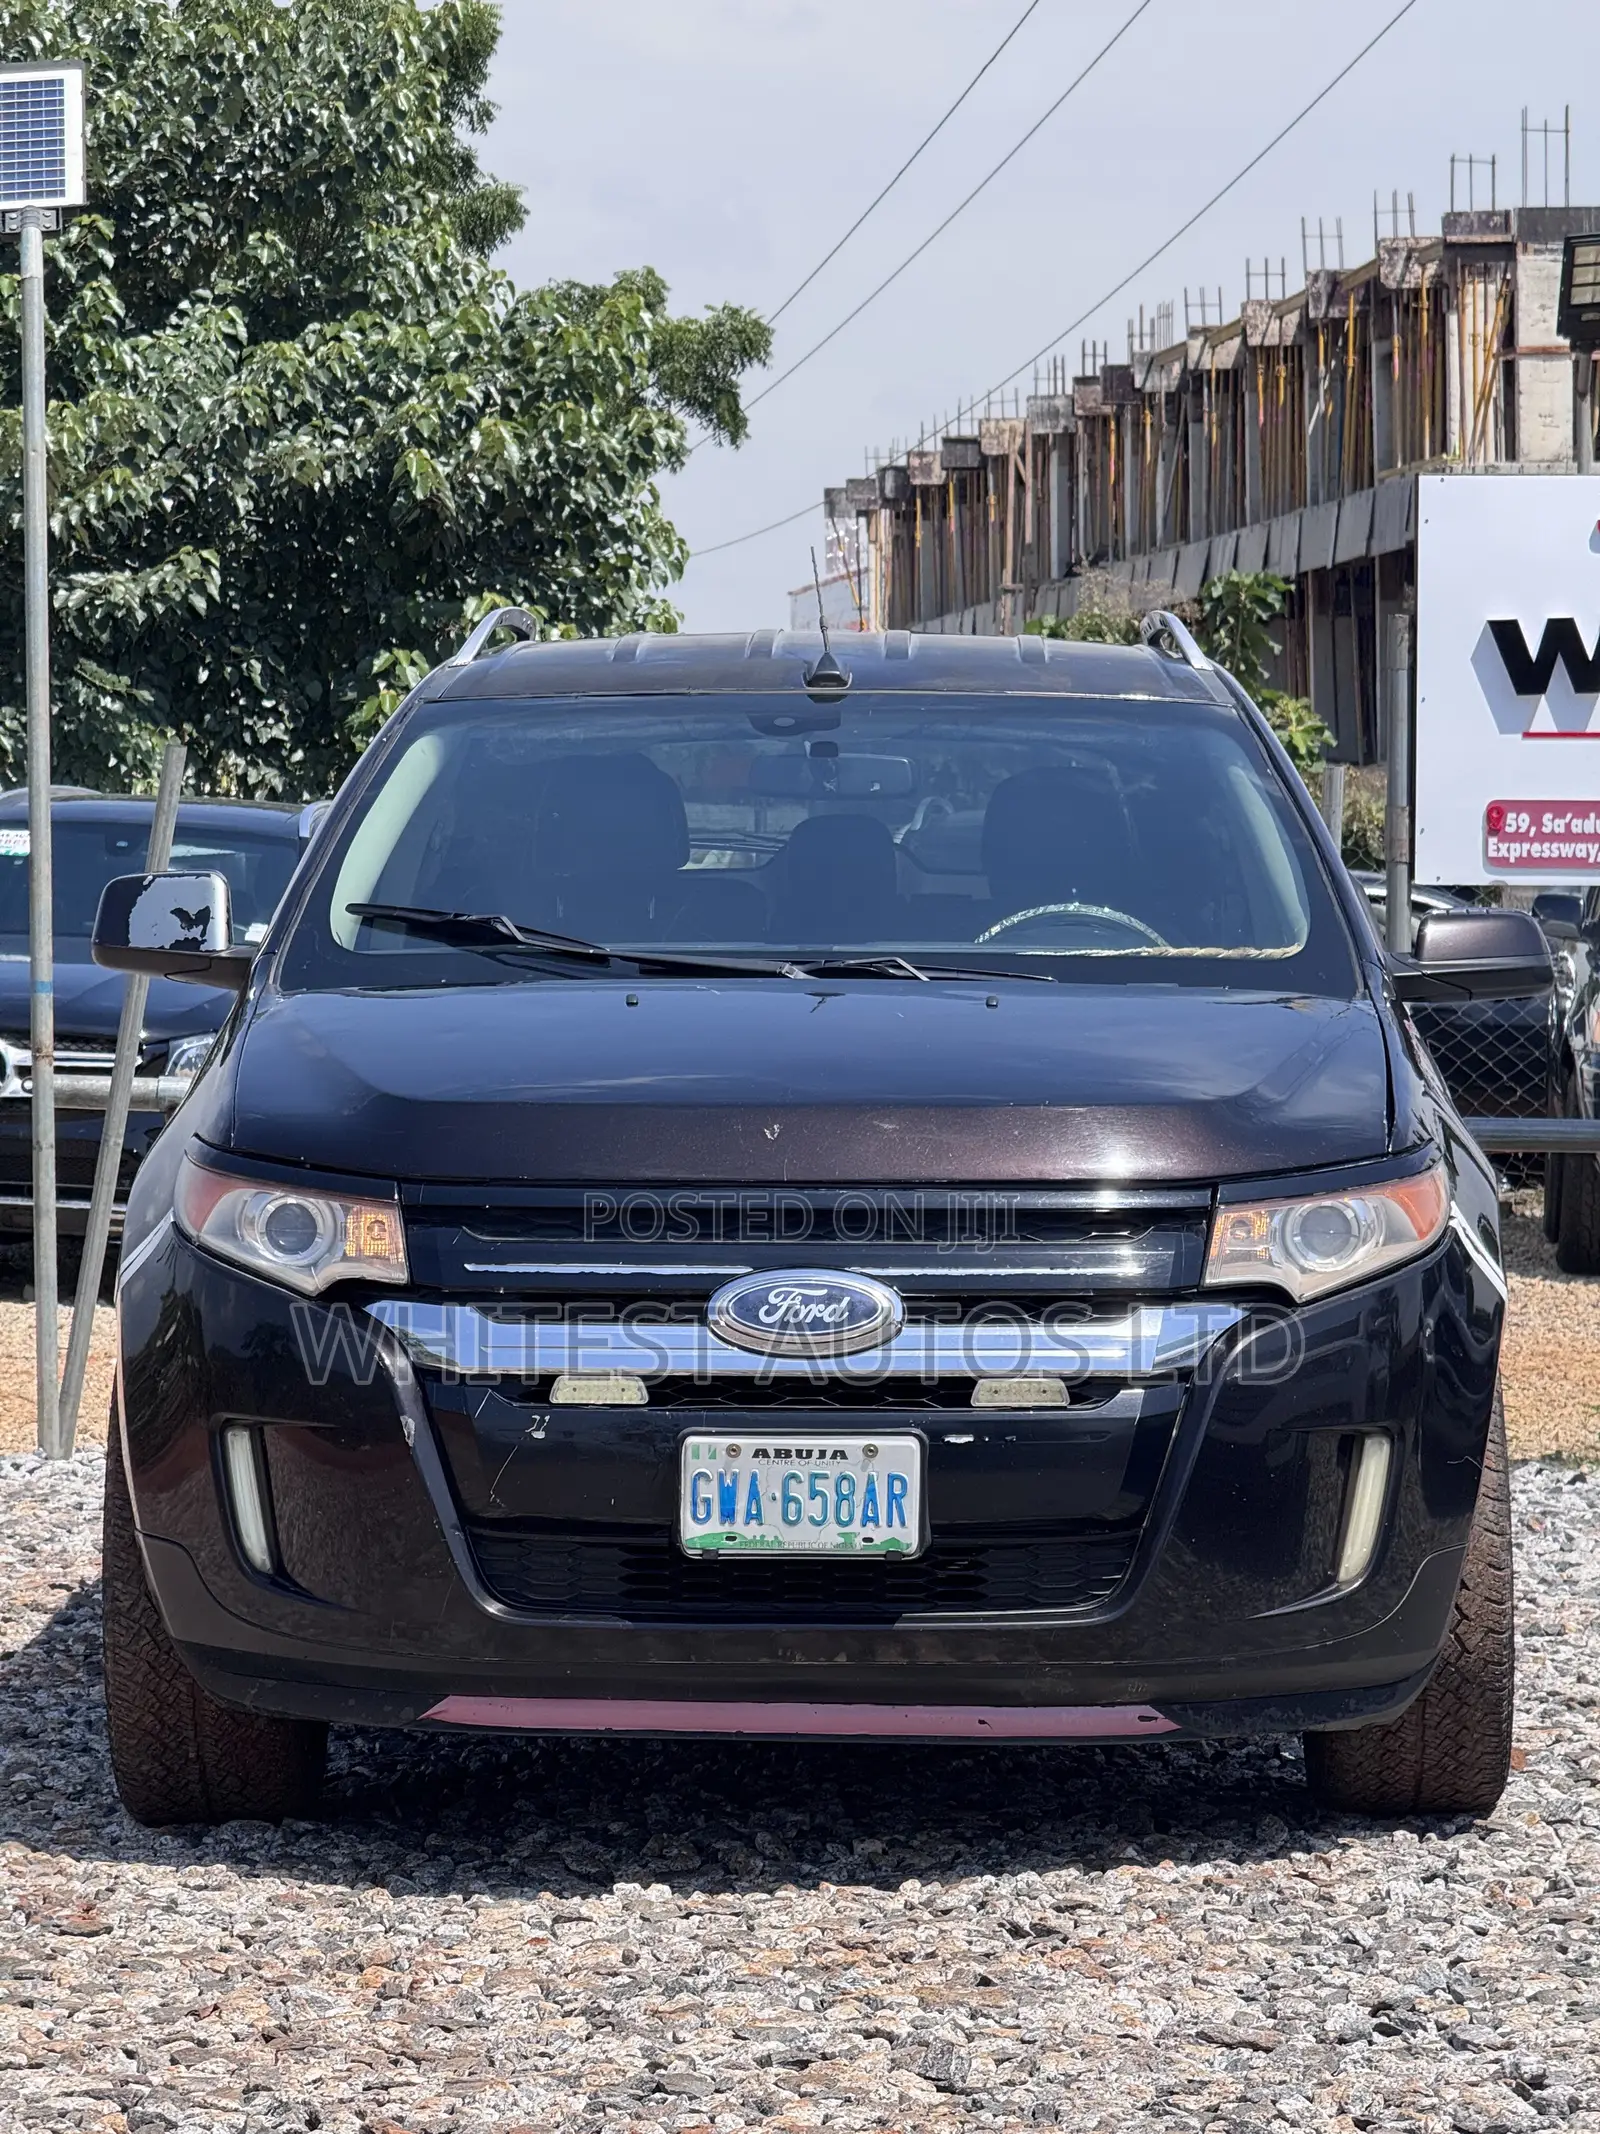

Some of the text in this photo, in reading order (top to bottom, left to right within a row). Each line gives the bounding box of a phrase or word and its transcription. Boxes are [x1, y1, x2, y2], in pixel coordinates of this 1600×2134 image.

[1505, 812, 1537, 838] 59,
[758, 1287, 850, 1324] Ford
[752, 1448, 848, 1460] ABUJA
[758, 1459, 795, 1467] CENTRE
[777, 1541, 817, 1549] REPUBLIC
